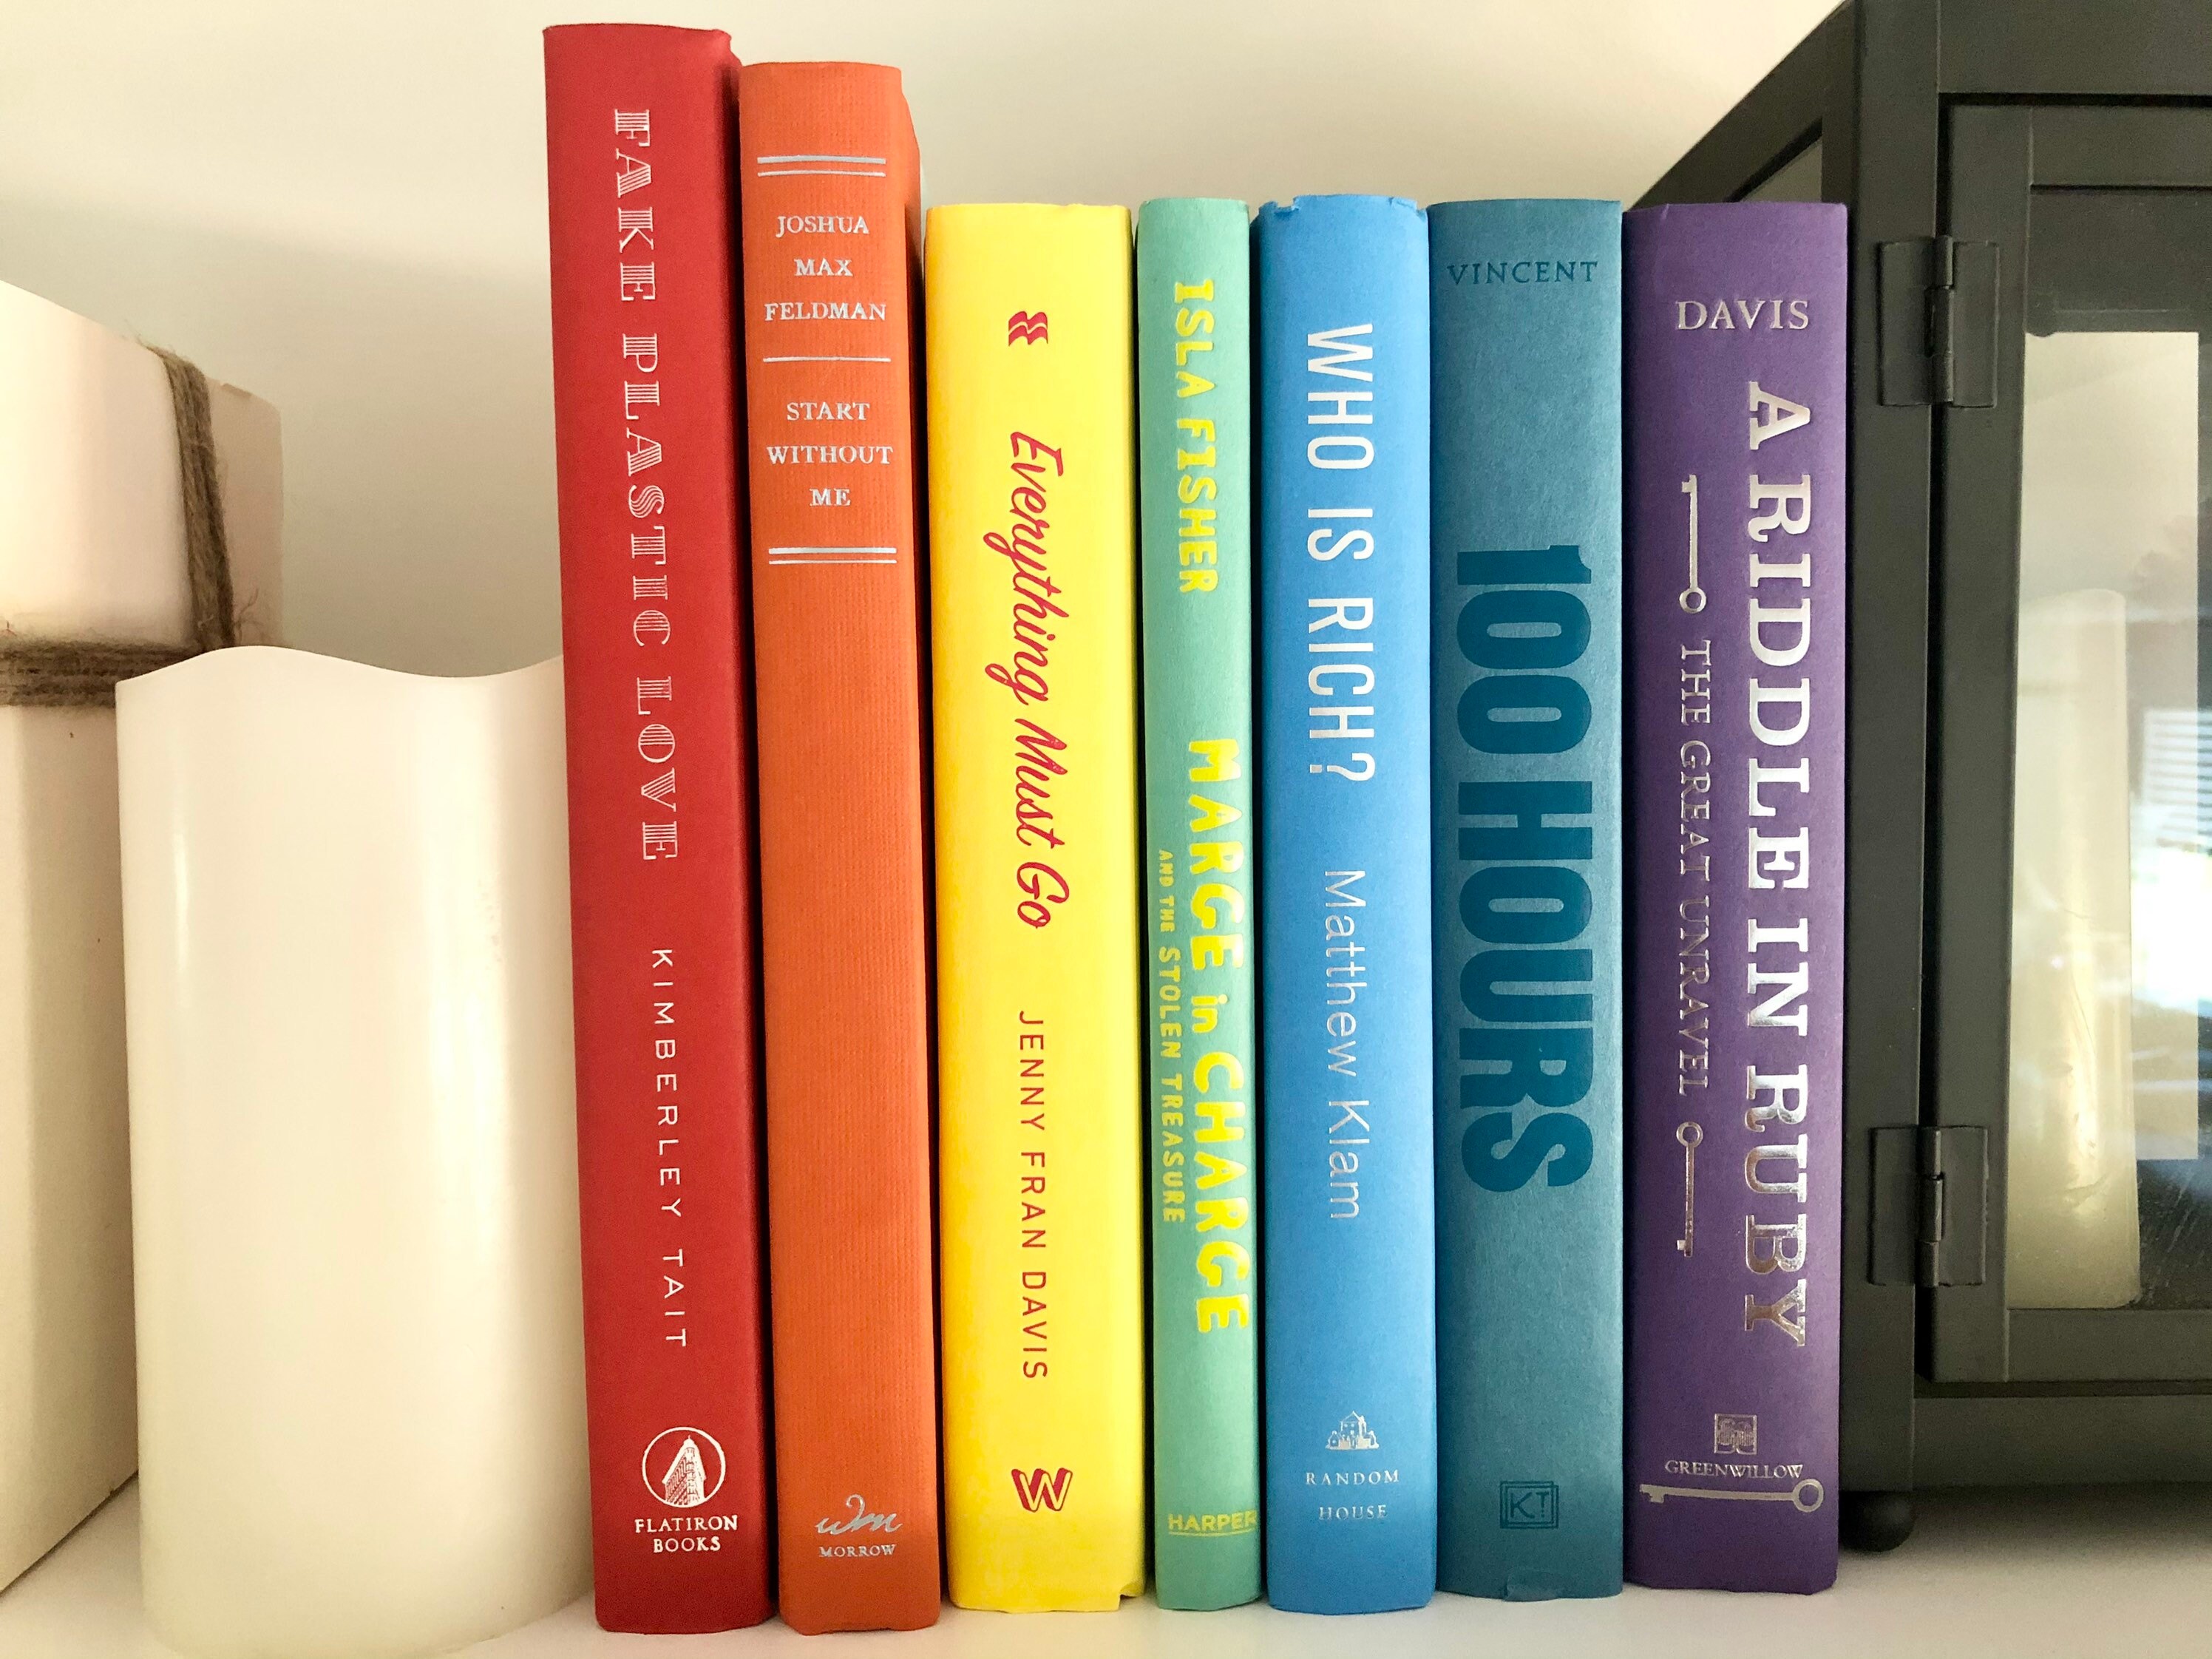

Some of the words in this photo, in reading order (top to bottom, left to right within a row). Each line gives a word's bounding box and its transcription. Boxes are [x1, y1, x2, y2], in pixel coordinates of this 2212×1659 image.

[614, 109, 656, 301] FAKE
[776, 215, 869, 238] JOSHUA
[764, 302, 887, 321] FELDMAN
[794, 259, 853, 277] MAX
[1447, 260, 1598, 285] VINCENT
[1675, 299, 1809, 330] DAVIS
[1175, 278, 1215, 398] ISLA
[786, 401, 870, 421] START
[1307, 323, 1374, 470] WHO
[1748, 381, 1811, 450] A
[622, 333, 671, 647] PLASTIC
[766, 444, 893, 465] WITHOUT
[810, 488, 852, 507] ME
[1177, 418, 1218, 594] FISHER
[983, 431, 1070, 706] Everything
[1307, 508, 1374, 561] IS
[1308, 597, 1376, 782] RICH?
[1456, 545, 1592, 755] 100
[1680, 639, 1711, 725] THE
[1747, 474, 1811, 890] RIDDLE
[637, 676, 678, 861] LOVE
[1014, 718, 1068, 849] Must
[1679, 739, 1711, 882] GREAT
[1016, 861, 1070, 929] Go
[1158, 849, 1174, 887] AND
[1188, 739, 1244, 970] MARGE
[1159, 895, 1175, 932] THE
[1159, 946, 1181, 1059] STOLEN
[1192, 994, 1229, 1033] in
[1324, 870, 1368, 1076] Matthew
[1458, 781, 1594, 1193] HOURS
[1678, 895, 1710, 1096] UNRAVEL
[1748, 917, 1809, 1037] IN
[651, 949, 682, 1218] KIMBERLEY
[1019, 1010, 1045, 1131] JENNY
[1020, 1152, 1047, 1249] FRAN
[1161, 1073, 1185, 1224] TREASURE
[1192, 1051, 1252, 1334] CHARGE
[1329, 1099, 1370, 1219] Klam
[1744, 1064, 1808, 1347] RUBY
[662, 1248, 687, 1348] TAIT
[1022, 1272, 1048, 1379] DAVIS
[1168, 1510, 1257, 1531] HARPER
[1305, 1470, 1400, 1486] RANDOM
[1319, 1504, 1388, 1521] HOUSE
[1665, 1459, 1803, 1479] GREENWILLOW
[634, 1514, 738, 1533] FLATIRON
[653, 1536, 722, 1553] BOOKS
[818, 1543, 897, 1558] MORROW
